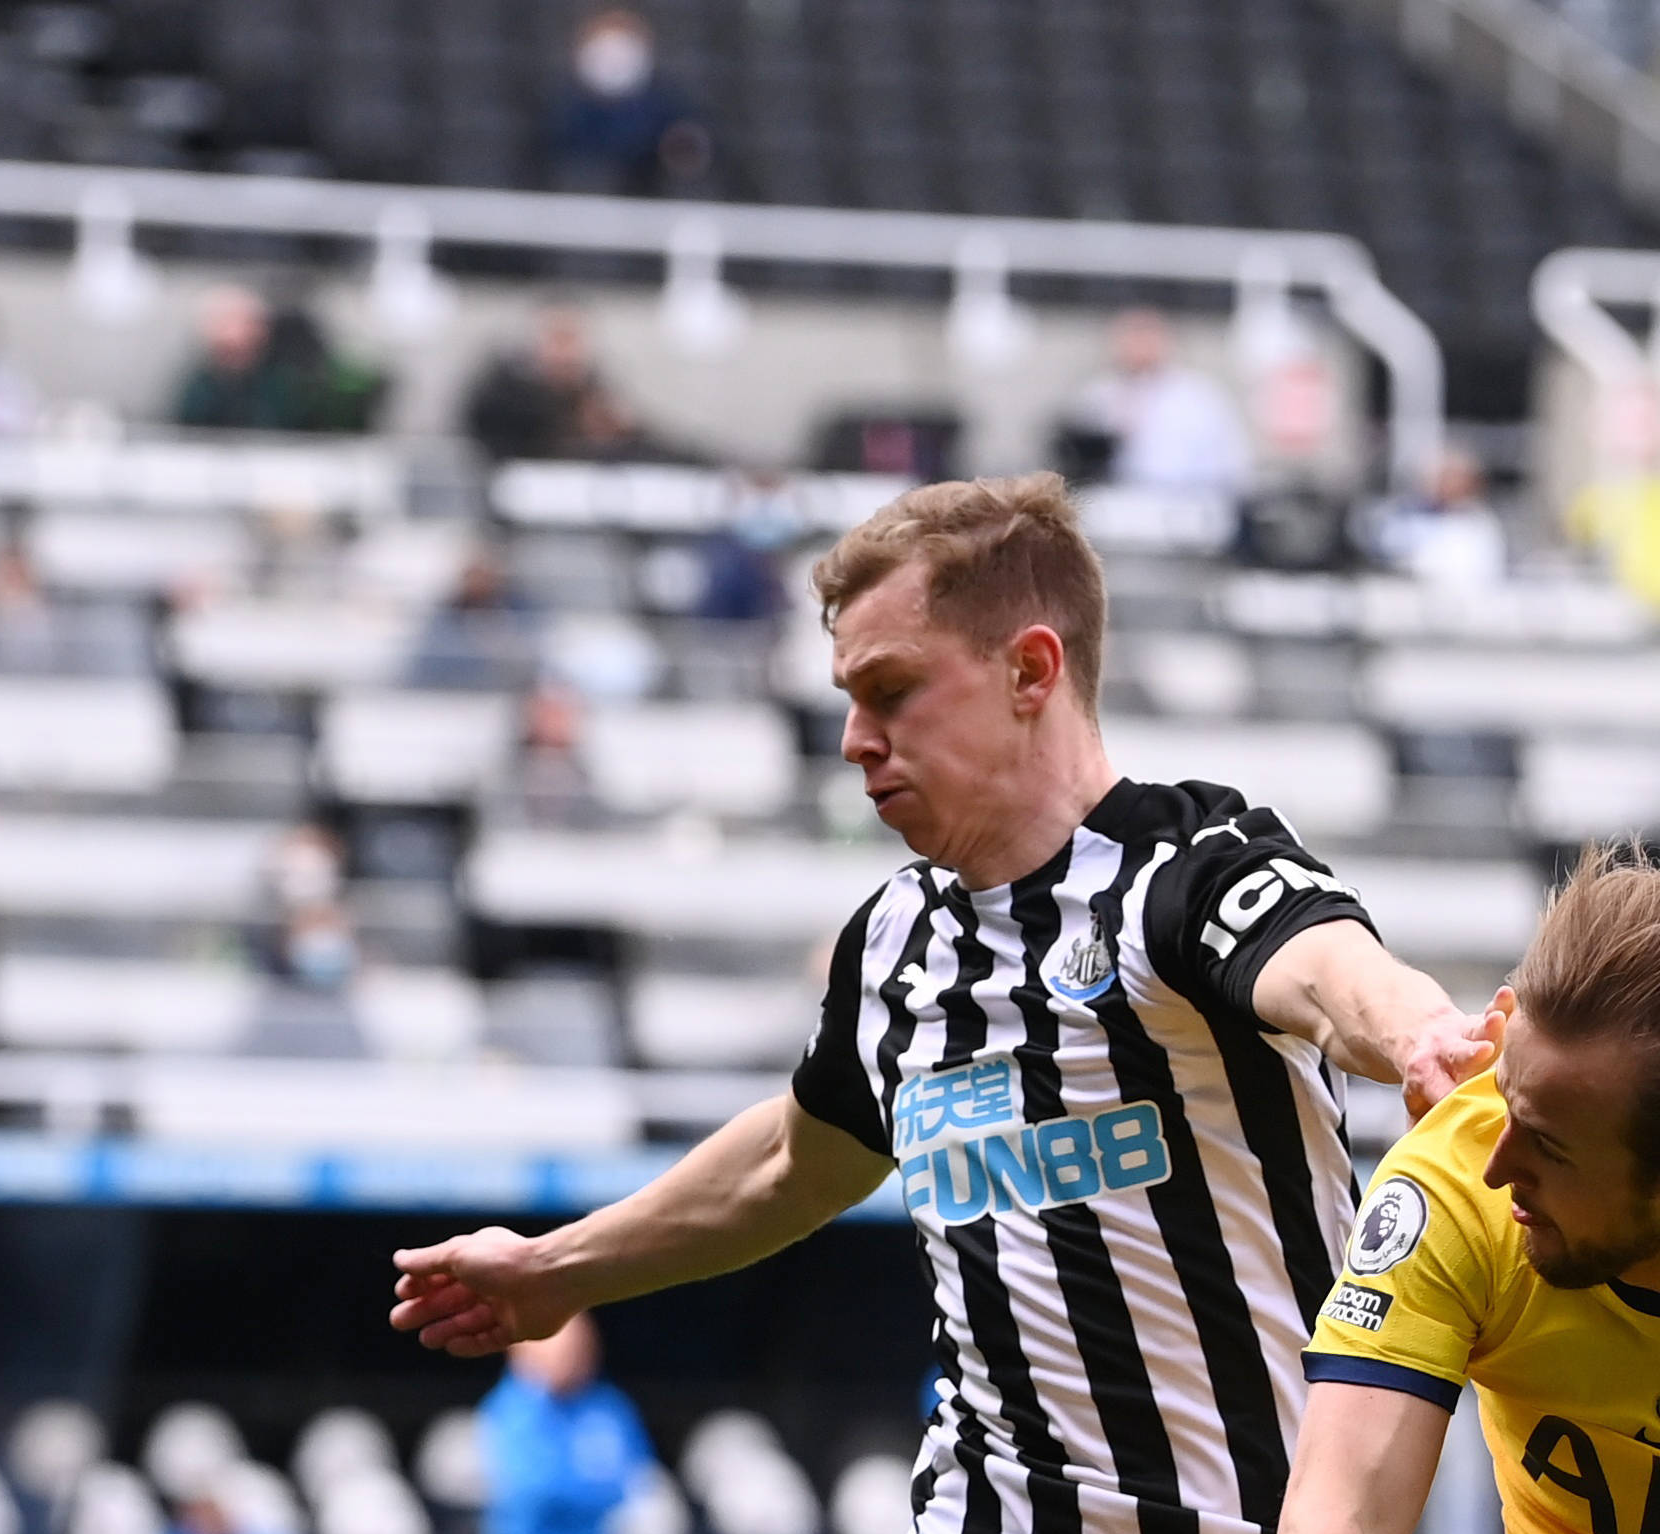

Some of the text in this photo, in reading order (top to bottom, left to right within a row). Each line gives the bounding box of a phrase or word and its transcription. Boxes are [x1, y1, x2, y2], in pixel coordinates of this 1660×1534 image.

[895, 1060, 1013, 1149] 乐天堂
[902, 1104, 1168, 1221] FUN88
